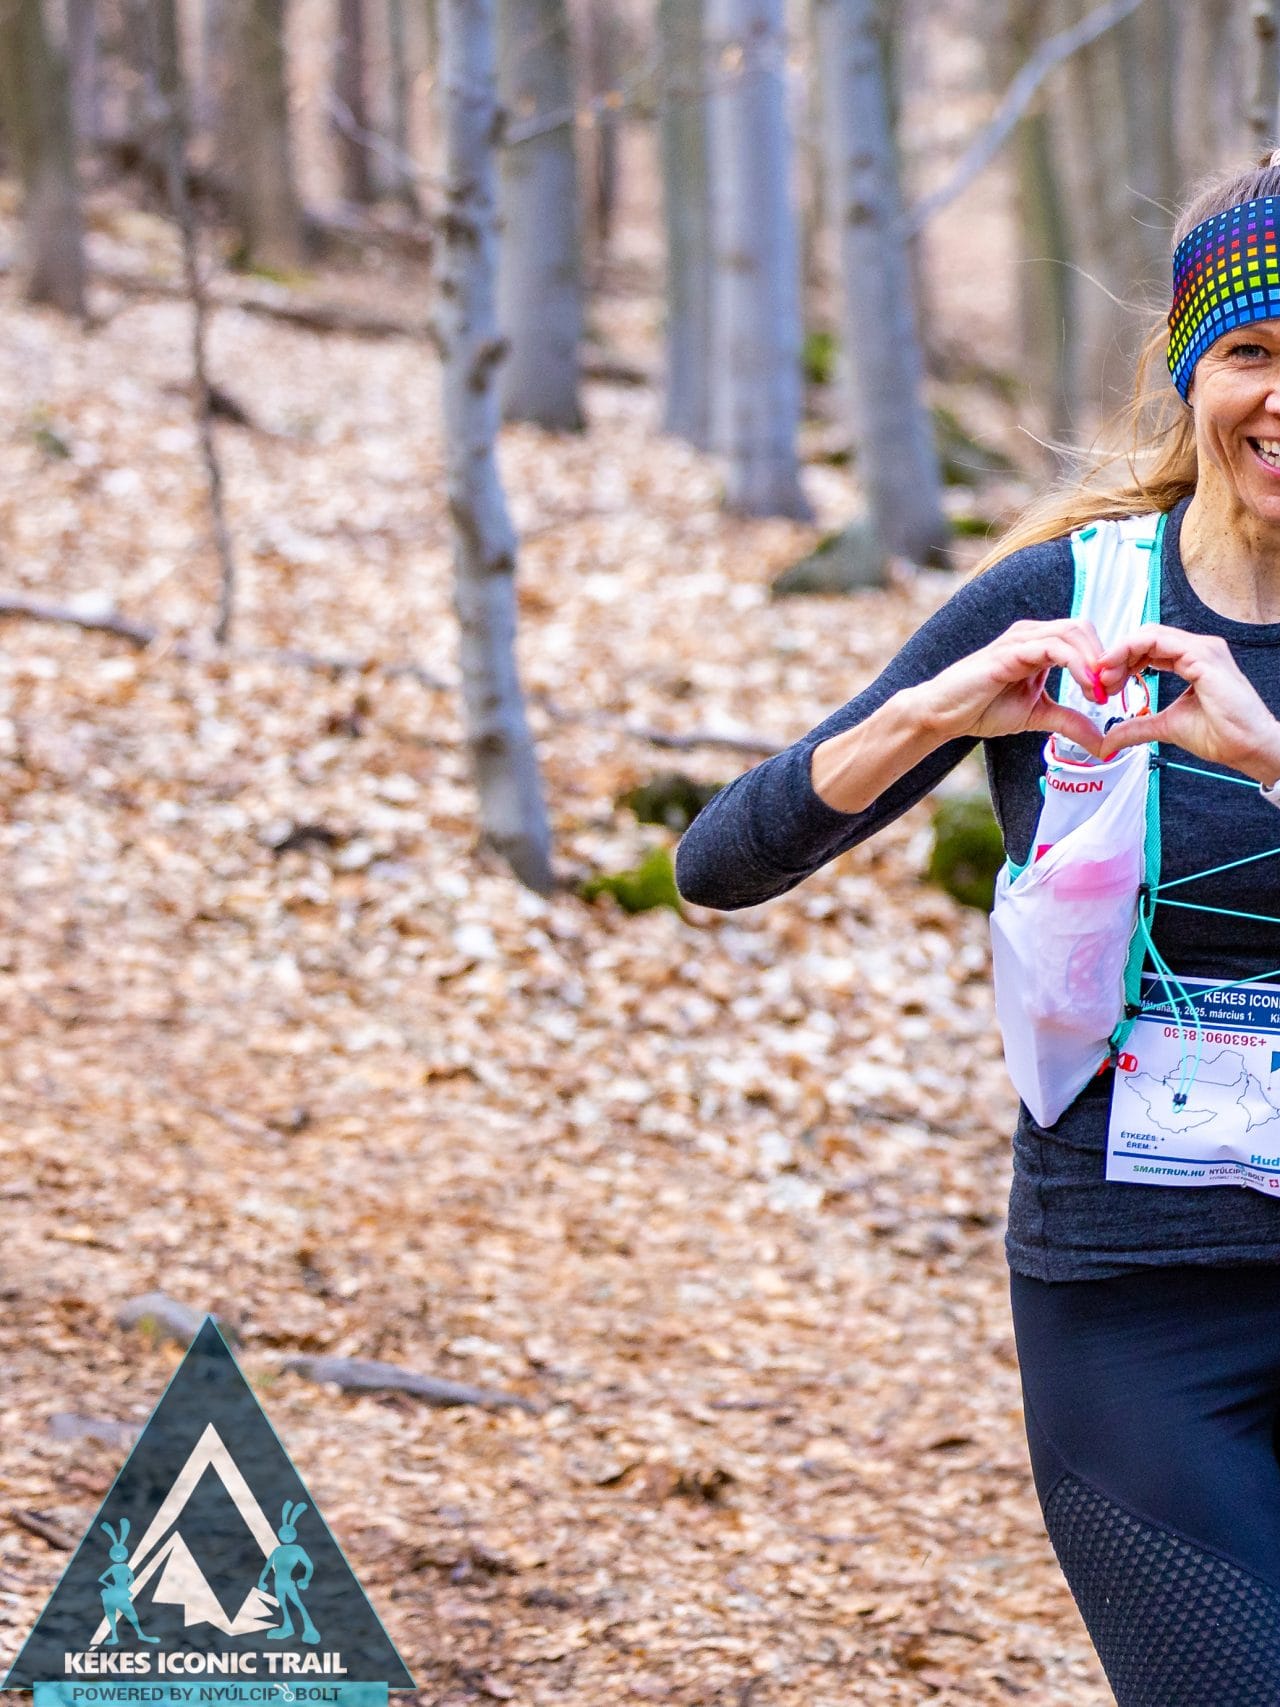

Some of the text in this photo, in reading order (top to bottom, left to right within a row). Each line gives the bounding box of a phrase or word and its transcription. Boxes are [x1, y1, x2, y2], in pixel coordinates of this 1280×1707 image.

[1047, 774, 1103, 793] LOMON
[1209, 1008, 1245, 1020] március
[1132, 1164, 1206, 1177] SMARTRUN.HU
